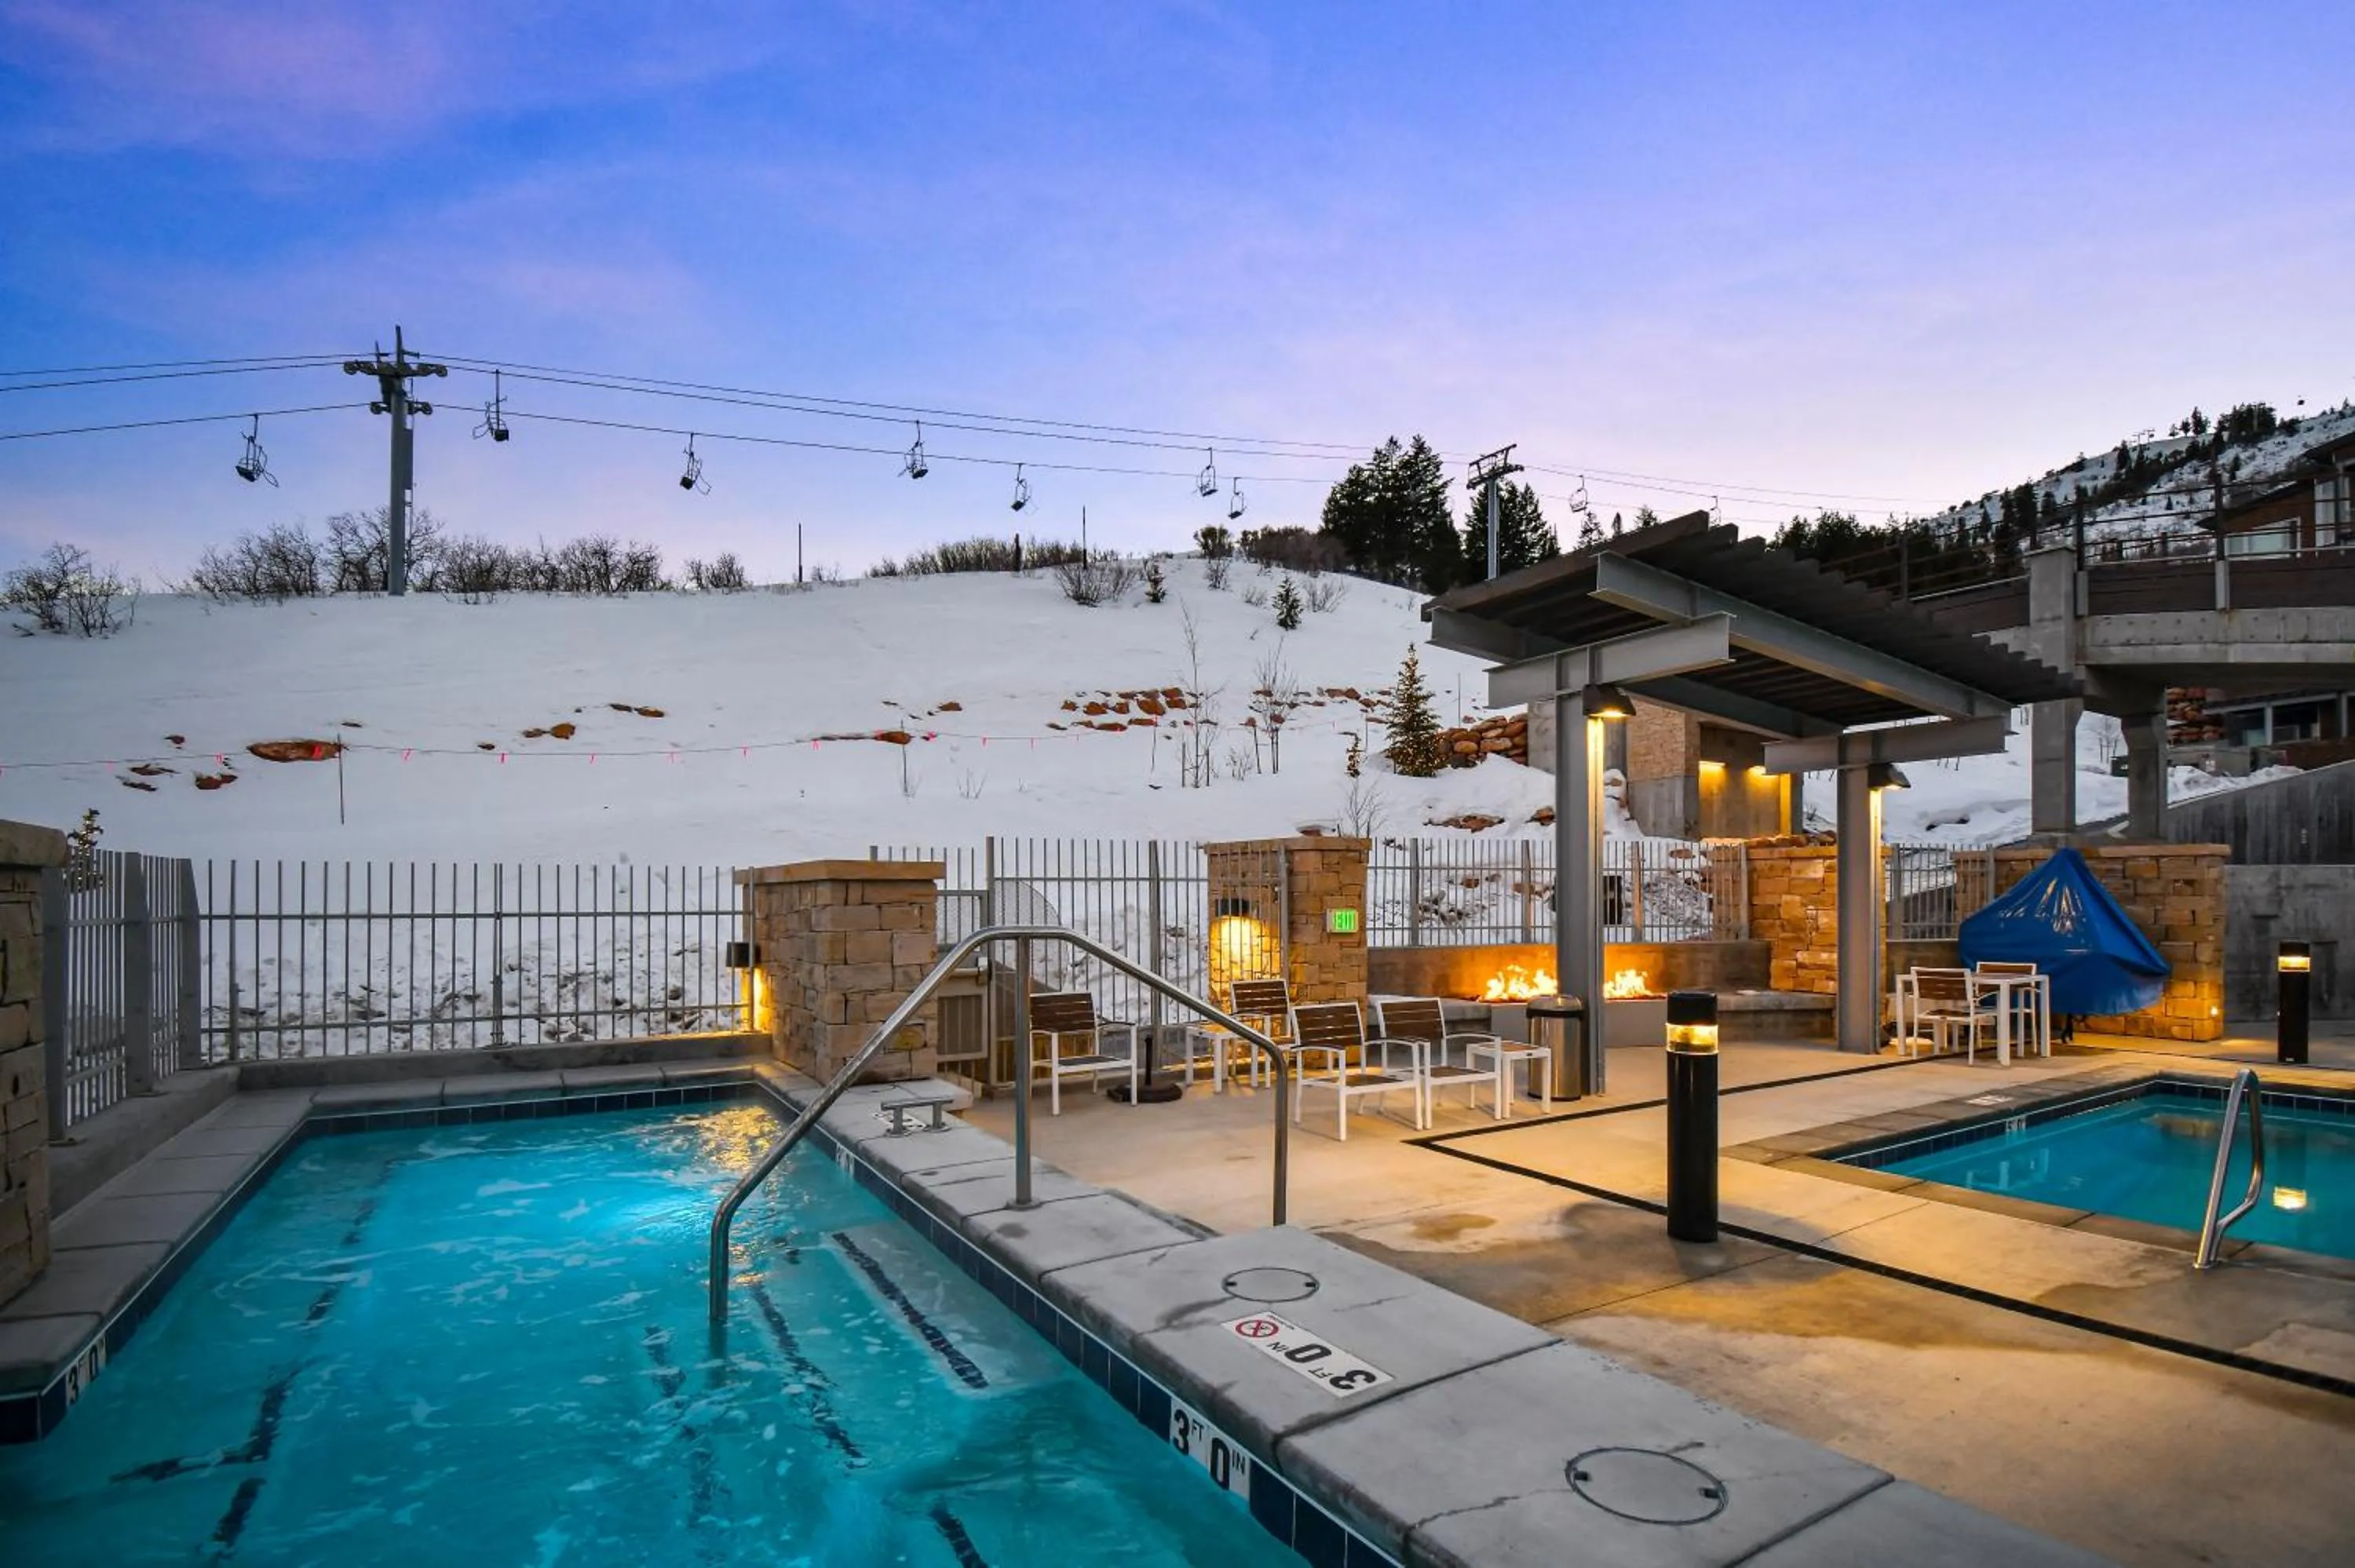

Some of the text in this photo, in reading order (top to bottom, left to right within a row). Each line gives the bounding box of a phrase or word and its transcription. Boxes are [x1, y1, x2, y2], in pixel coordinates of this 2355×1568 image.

[1266, 1341, 1377, 1390] 3 FT 0 IN
[1172, 1409, 1246, 1490] 3 FT 0 IN
